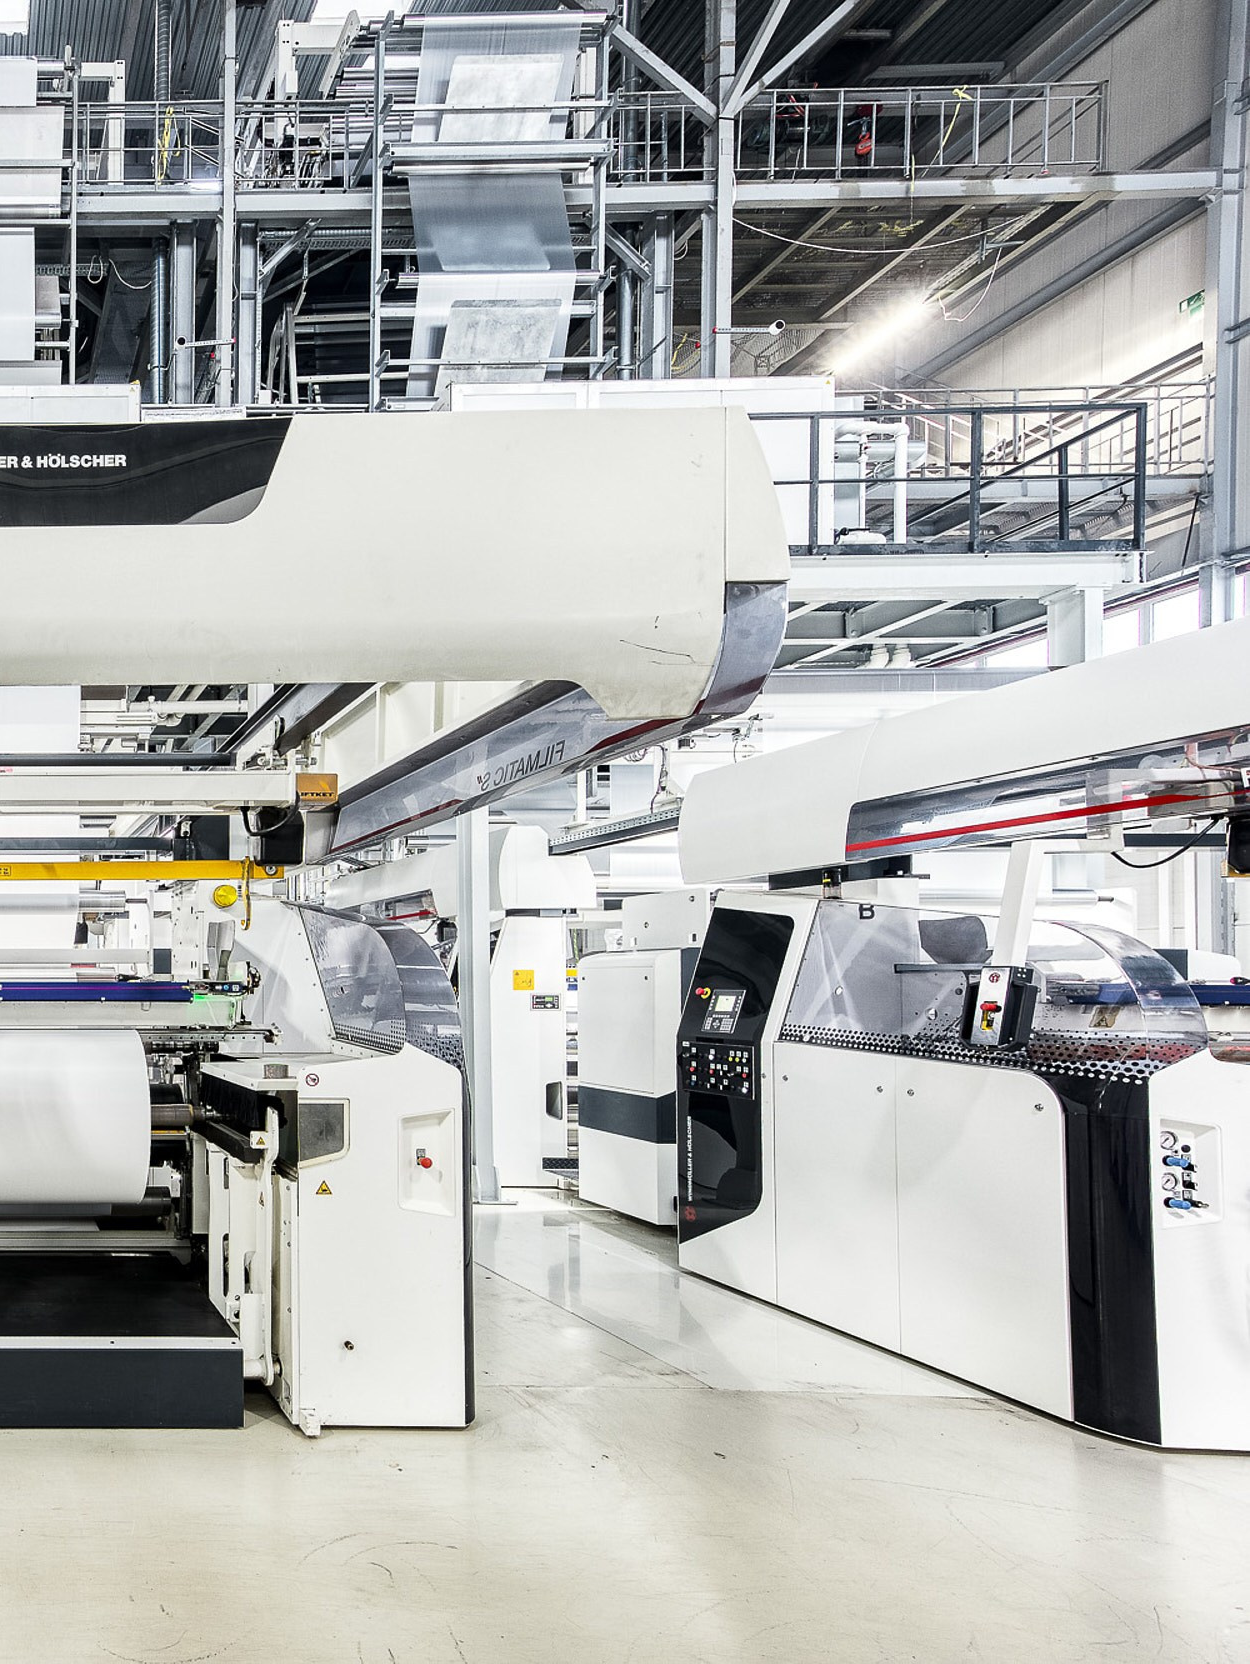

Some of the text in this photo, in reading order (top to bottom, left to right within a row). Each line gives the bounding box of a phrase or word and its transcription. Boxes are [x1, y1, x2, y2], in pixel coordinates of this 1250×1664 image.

[21, 455, 34, 468] &
[36, 453, 127, 468] HÖLSCHER
[859, 903, 875, 919] B
